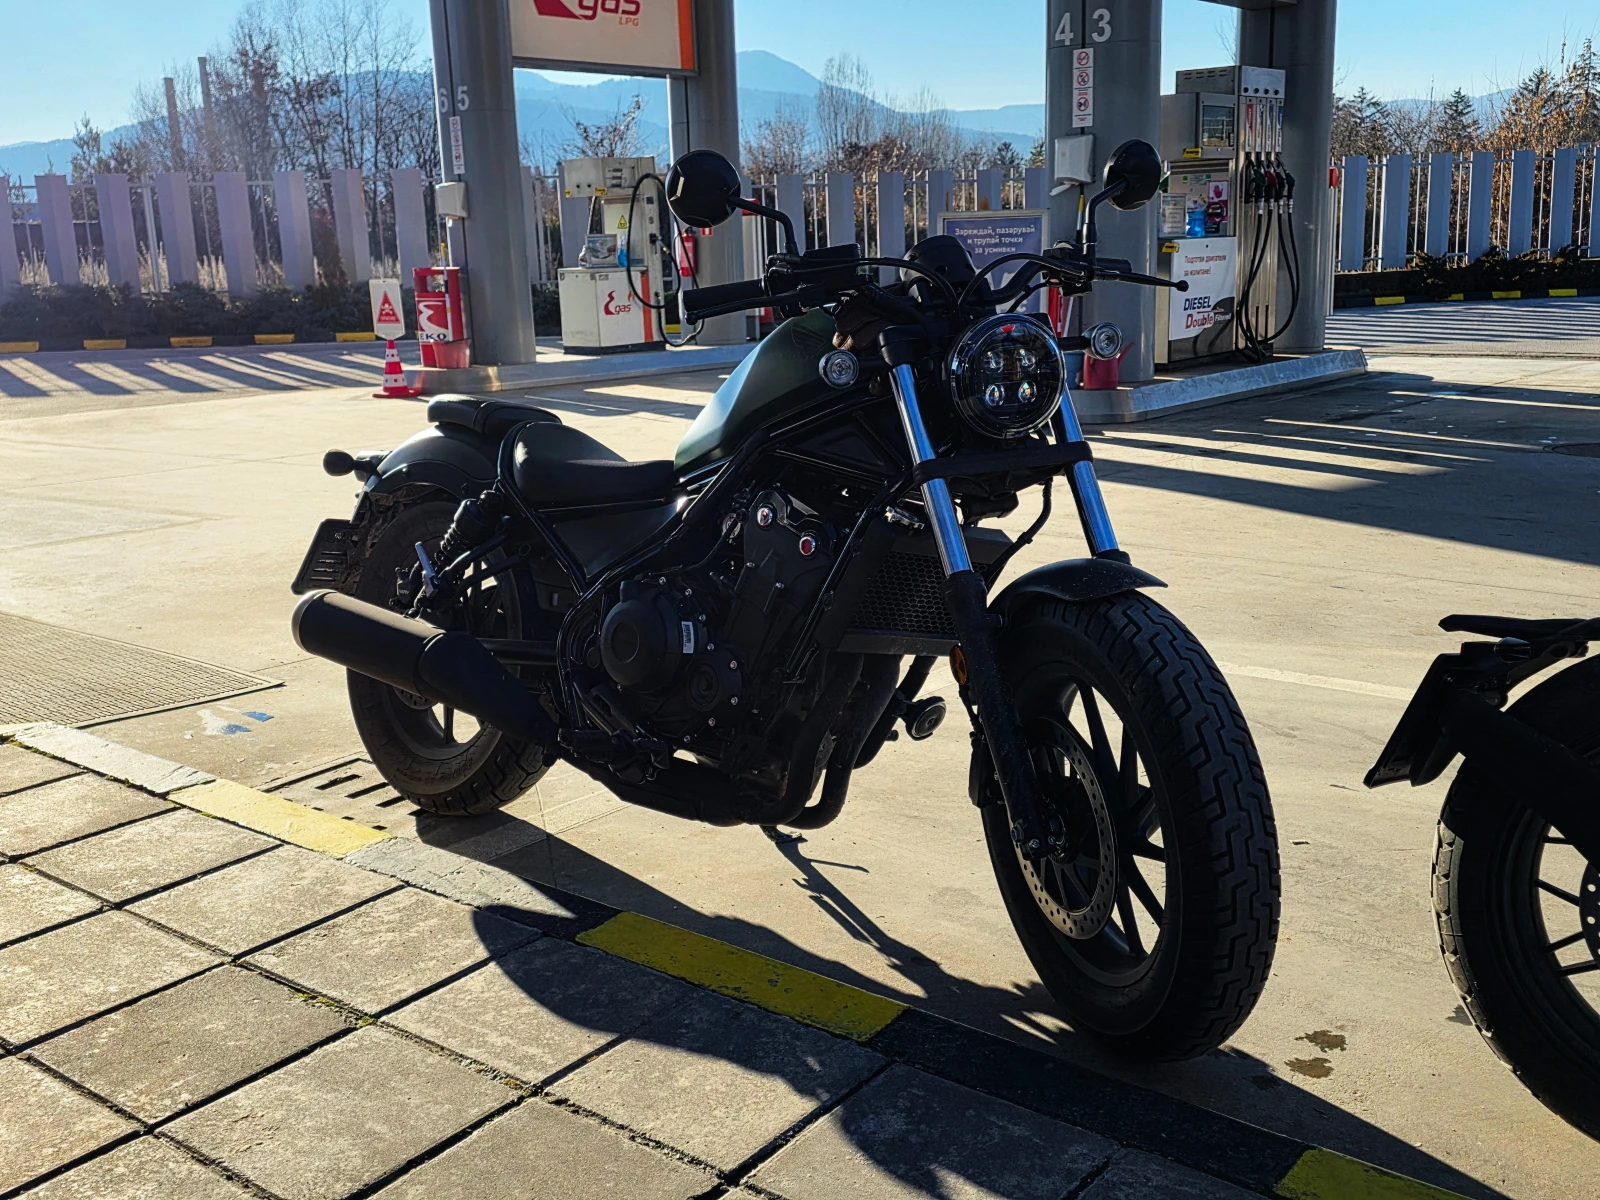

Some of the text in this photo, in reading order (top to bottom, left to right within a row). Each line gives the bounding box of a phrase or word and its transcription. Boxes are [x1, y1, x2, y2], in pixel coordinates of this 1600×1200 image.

[578, 0, 640, 20] gas
[619, 16, 639, 26] LPG
[1055, 8, 1112, 45] 4 3
[439, 85, 469, 113] 6 5
[955, 225, 1035, 236] Зареждай, пазарувай
[974, 236, 999, 245] трупай
[984, 246, 1016, 255] усмивки
[1184, 296, 1211, 311] DIESEL
[615, 304, 631, 315] gas
[1185, 313, 1213, 329] Double
[419, 332, 447, 341] EKO
